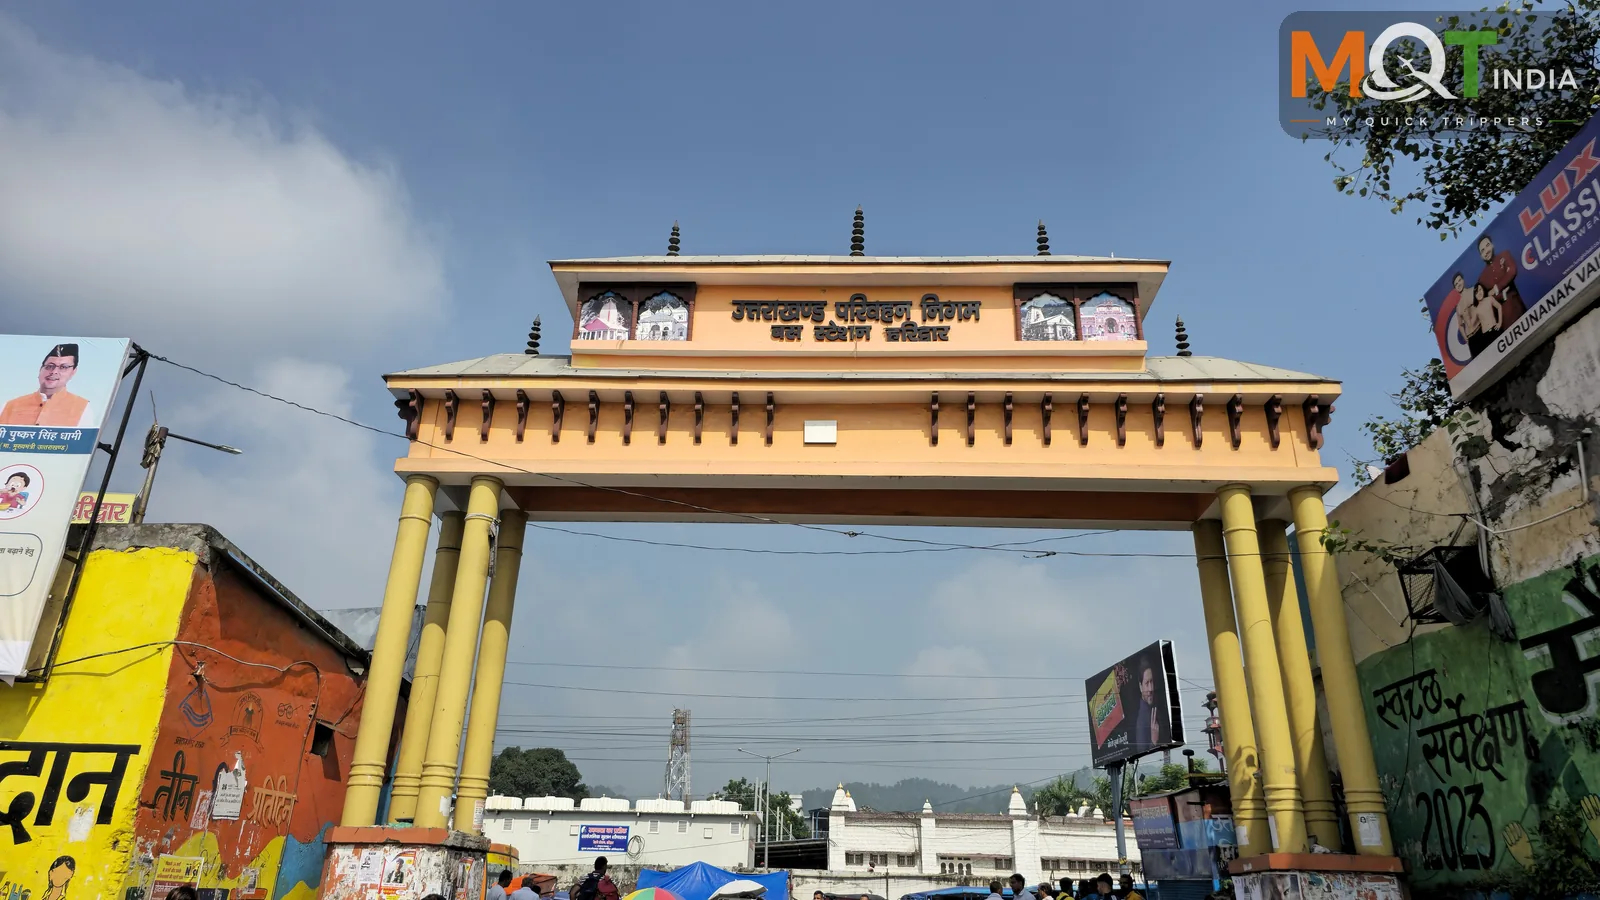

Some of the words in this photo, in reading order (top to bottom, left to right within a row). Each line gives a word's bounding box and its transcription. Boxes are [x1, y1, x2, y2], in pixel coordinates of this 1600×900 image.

[1518, 136, 1600, 237] LUX
[1546, 213, 1600, 266] UNDERWEA
[732, 299, 828, 323] उत्तराखण्ड
[835, 293, 913, 324] परिवहन
[920, 293, 982, 322] निगम
[1497, 277, 1576, 354] GURUNANAK
[1576, 253, 1600, 283] VAI
[771, 324, 804, 341] बस
[814, 320, 872, 342] स्टेशन
[8, 430, 37, 442] पुष्कर
[38, 428, 58, 441] सिंह
[60, 429, 83, 441] धामी
[1416, 783, 1496, 872] 2023
